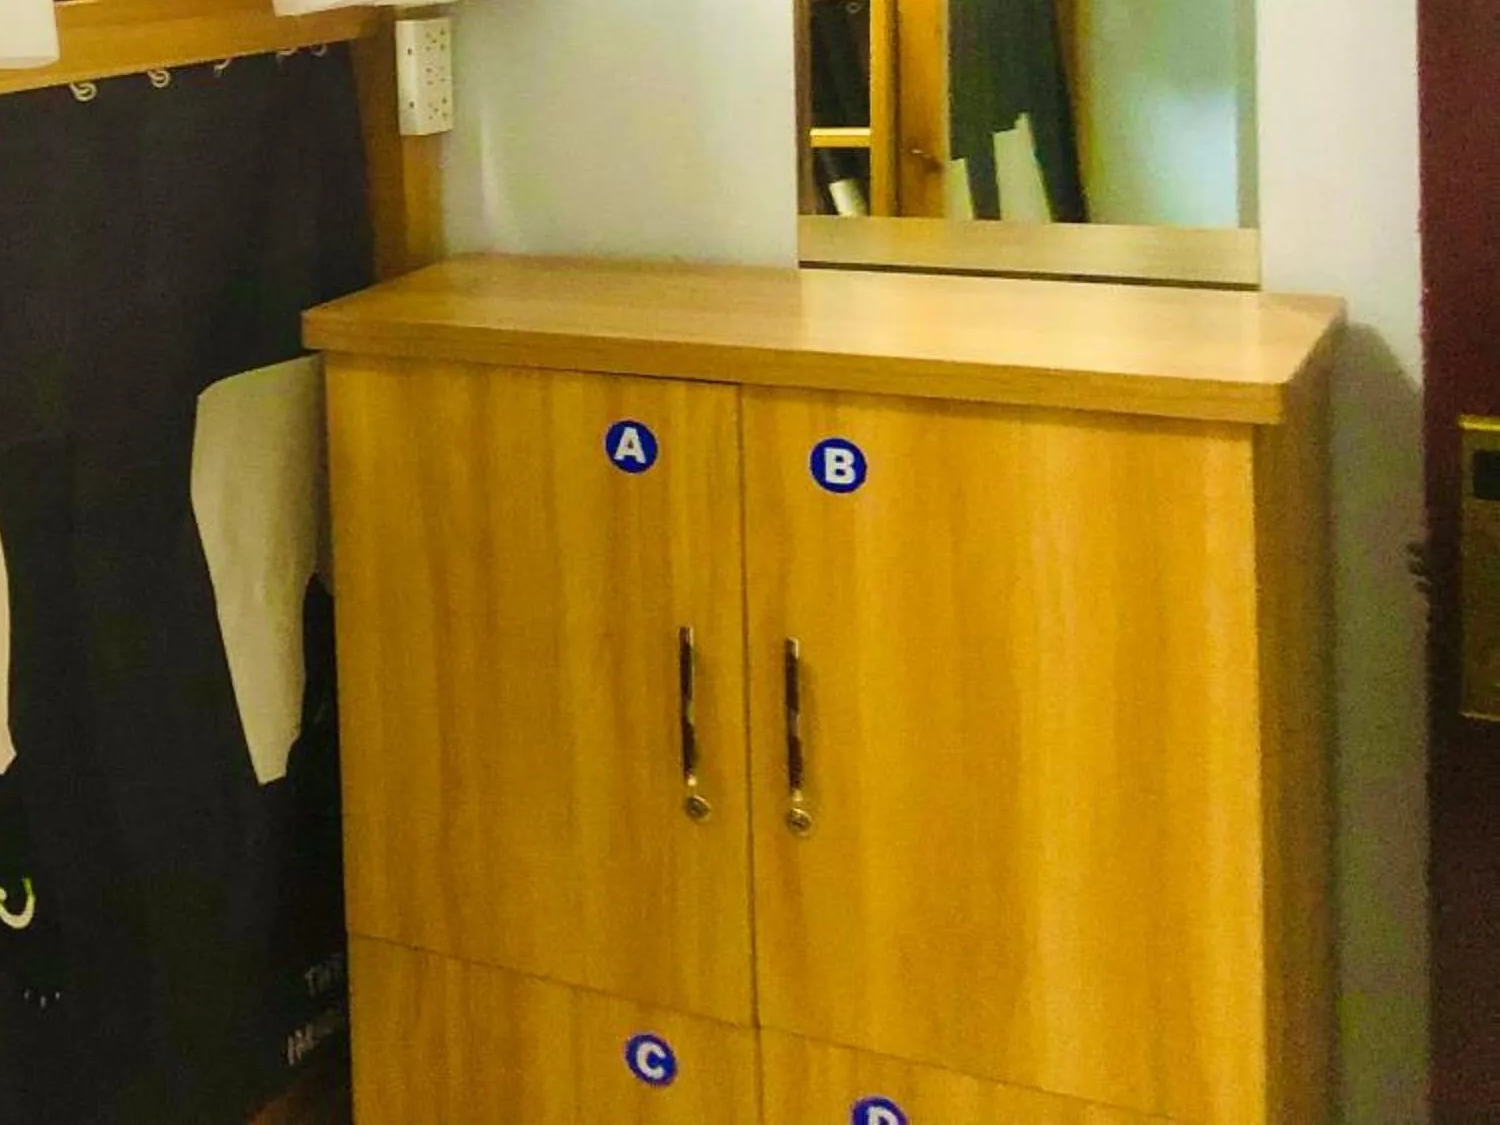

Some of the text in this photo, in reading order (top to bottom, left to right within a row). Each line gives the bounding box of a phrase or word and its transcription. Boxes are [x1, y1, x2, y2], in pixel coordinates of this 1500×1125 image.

[613, 426, 648, 465] A
[823, 446, 857, 485] B
[635, 1040, 667, 1080] C
